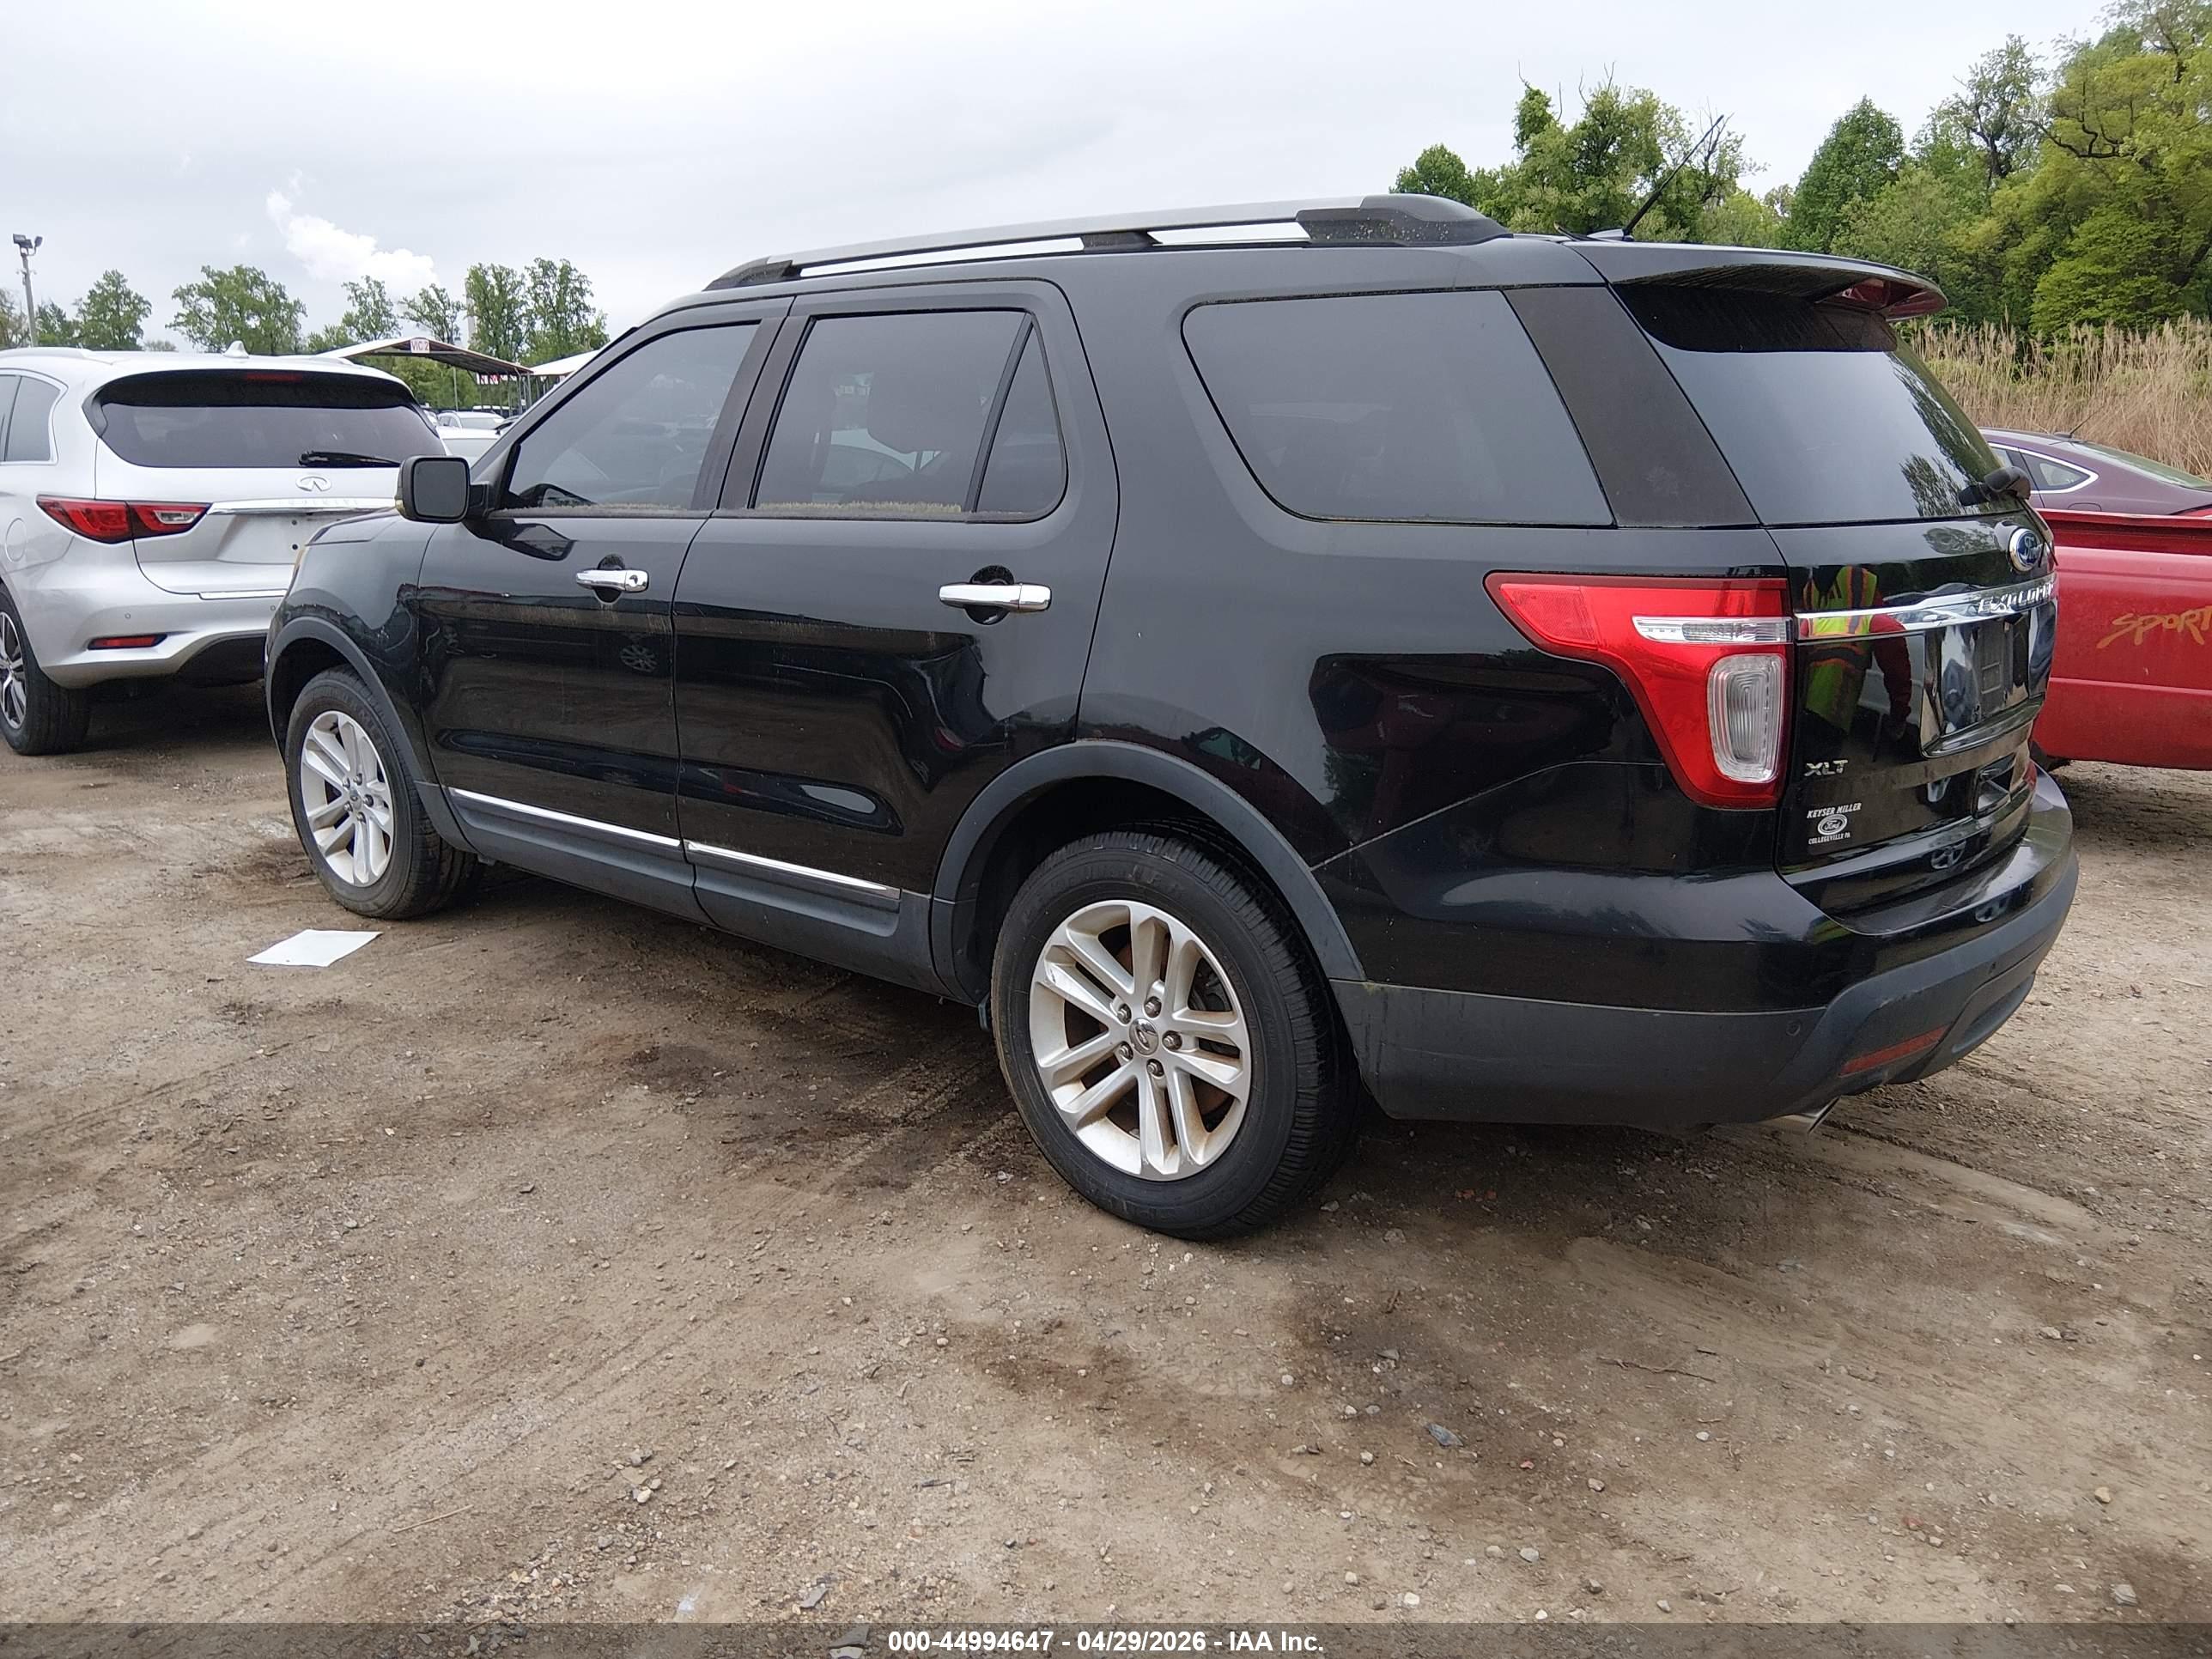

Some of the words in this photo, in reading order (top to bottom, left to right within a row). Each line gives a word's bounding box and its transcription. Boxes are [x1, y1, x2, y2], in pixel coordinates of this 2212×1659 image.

[411, 340, 422, 350] VIC
[1804, 759, 1848, 776] XLT
[1807, 807, 1835, 818] KEYSER
[1837, 802, 1862, 814] MILLER
